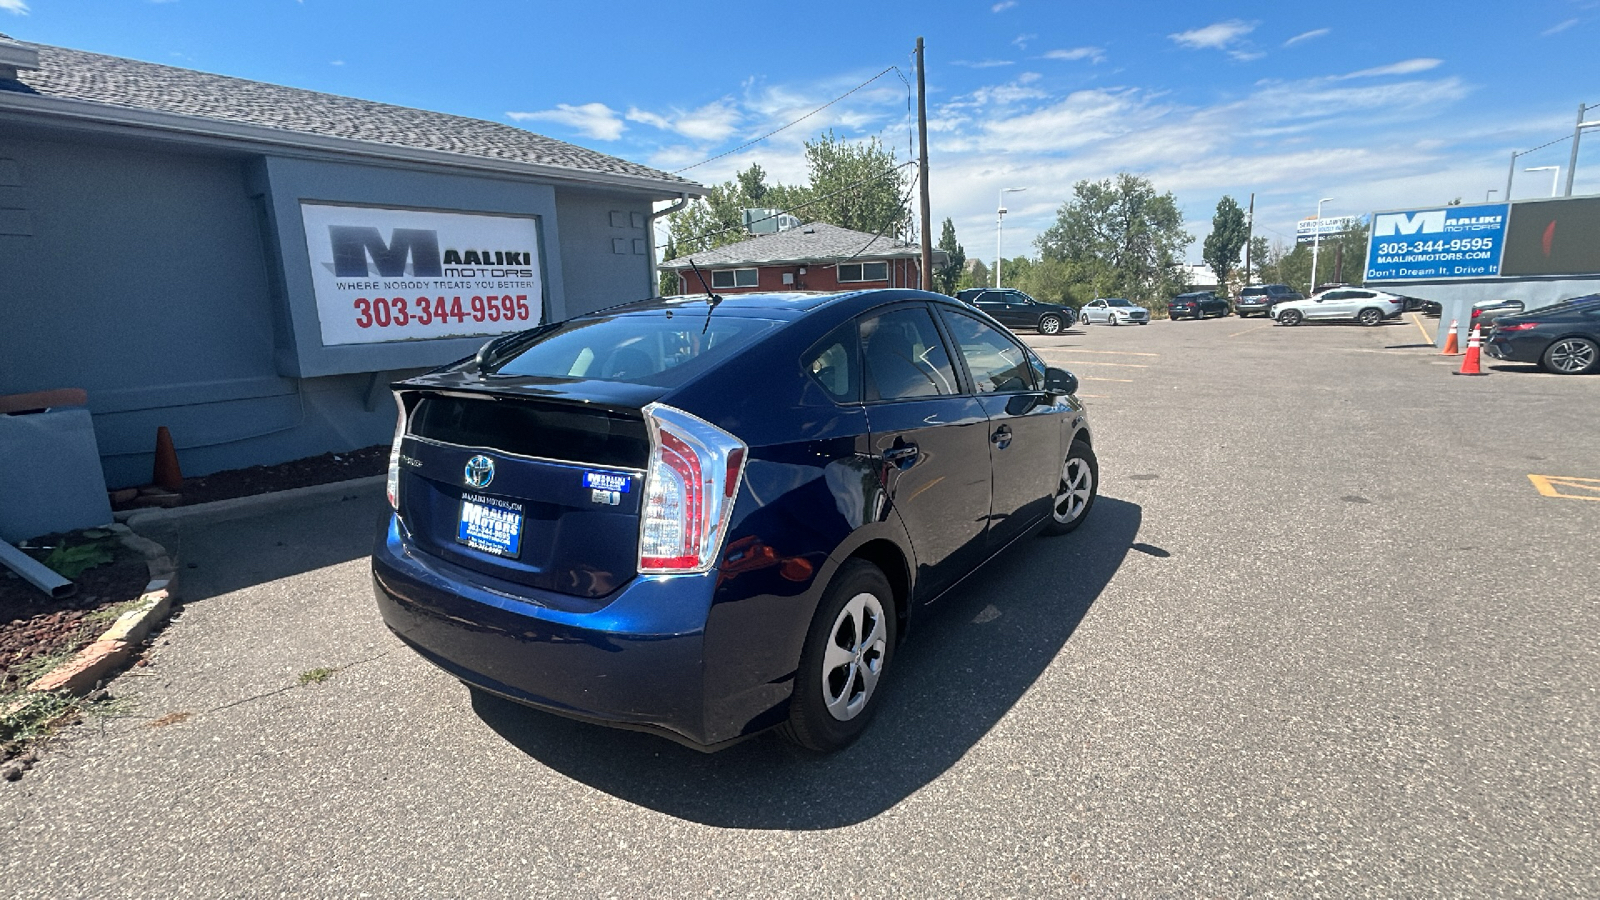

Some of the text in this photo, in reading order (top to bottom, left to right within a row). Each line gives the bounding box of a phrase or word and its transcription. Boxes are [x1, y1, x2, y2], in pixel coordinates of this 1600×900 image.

[1299, 219, 1323, 228] SERIOS
[1444, 223, 1501, 233] MOTORS
[1378, 237, 1493, 255] 303-344-9595
[1377, 251, 1491, 264] MAALIKIMOTORS.COM
[444, 267, 533, 278] MOTORS
[1368, 268, 1396, 278] Don't
[1399, 267, 1435, 276] Dream
[1454, 265, 1485, 274] Drive
[1489, 265, 1497, 273] It
[337, 281, 380, 291] WHERE
[384, 281, 430, 290] NOBODY
[433, 281, 472, 289] TREATS
[475, 281, 494, 289] YOU
[353, 294, 530, 329] 303-344-9595
